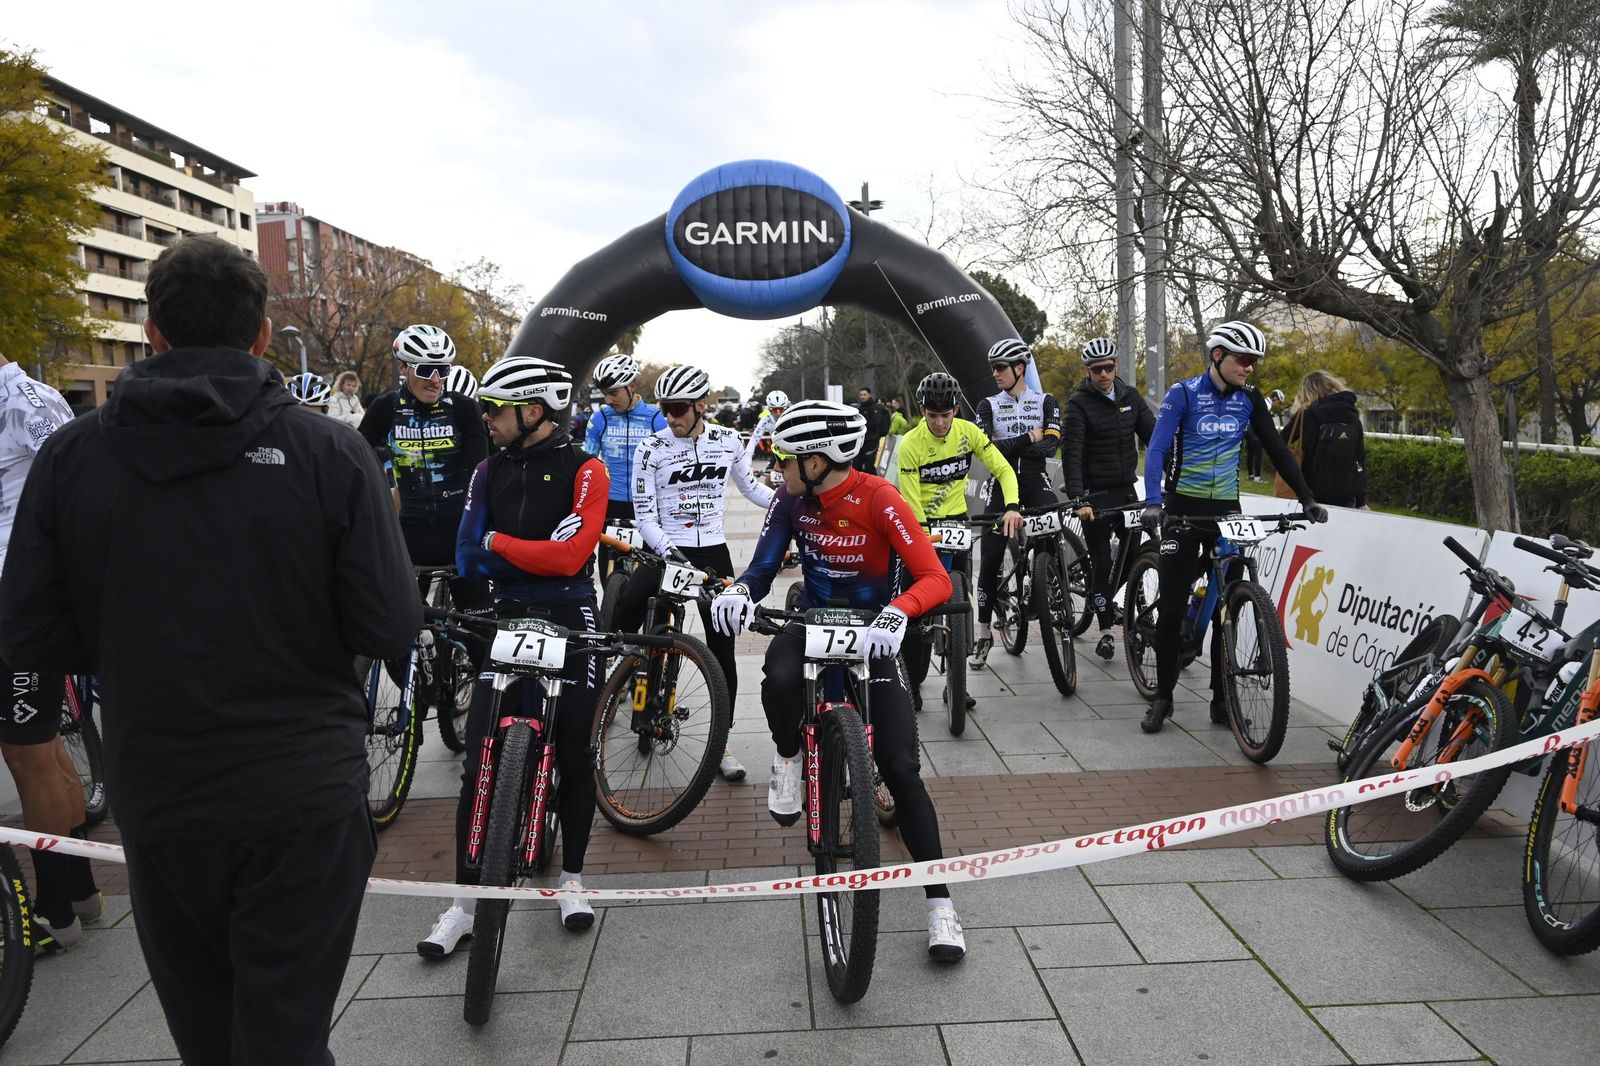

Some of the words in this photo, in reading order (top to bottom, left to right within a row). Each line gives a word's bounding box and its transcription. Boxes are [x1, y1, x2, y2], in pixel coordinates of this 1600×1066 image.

[540, 305, 608, 322] garmin.com
[916, 290, 981, 315] garmin.com
[523, 385, 549, 396] GIST
[1200, 422, 1237, 432] KMC
[398, 440, 450, 448] ORBEA
[806, 440, 834, 451] GIST
[668, 462, 728, 485] KTM
[576, 481, 590, 509] KENDA
[678, 502, 715, 510] KOMETA
[616, 528, 634, 541] 5-1
[893, 519, 914, 545] KENDA
[1029, 515, 1055, 533] 25-2
[1227, 522, 1256, 537] 12-1
[820, 554, 864, 563] KENDA
[672, 569, 694, 591] 6-2
[1338, 583, 1435, 636] Diputació
[512, 633, 546, 661] 7-1
[823, 629, 858, 654] 7-2
[1517, 620, 1550, 651] 4-2
[1326, 625, 1348, 657] de
[1353, 633, 1406, 676] Córd
[1408, 718, 1429, 744] FOX
[809, 751, 820, 831] MANITOU
[470, 763, 492, 845] MANITOU
[526, 770, 549, 851] MANITOU
[1075, 817, 1206, 851] octagon
[1329, 808, 1338, 841] SCORPI
[1527, 799, 1543, 857] PIRELLI
[772, 867, 912, 889] octagon
[13, 879, 31, 947] MAXXIS
